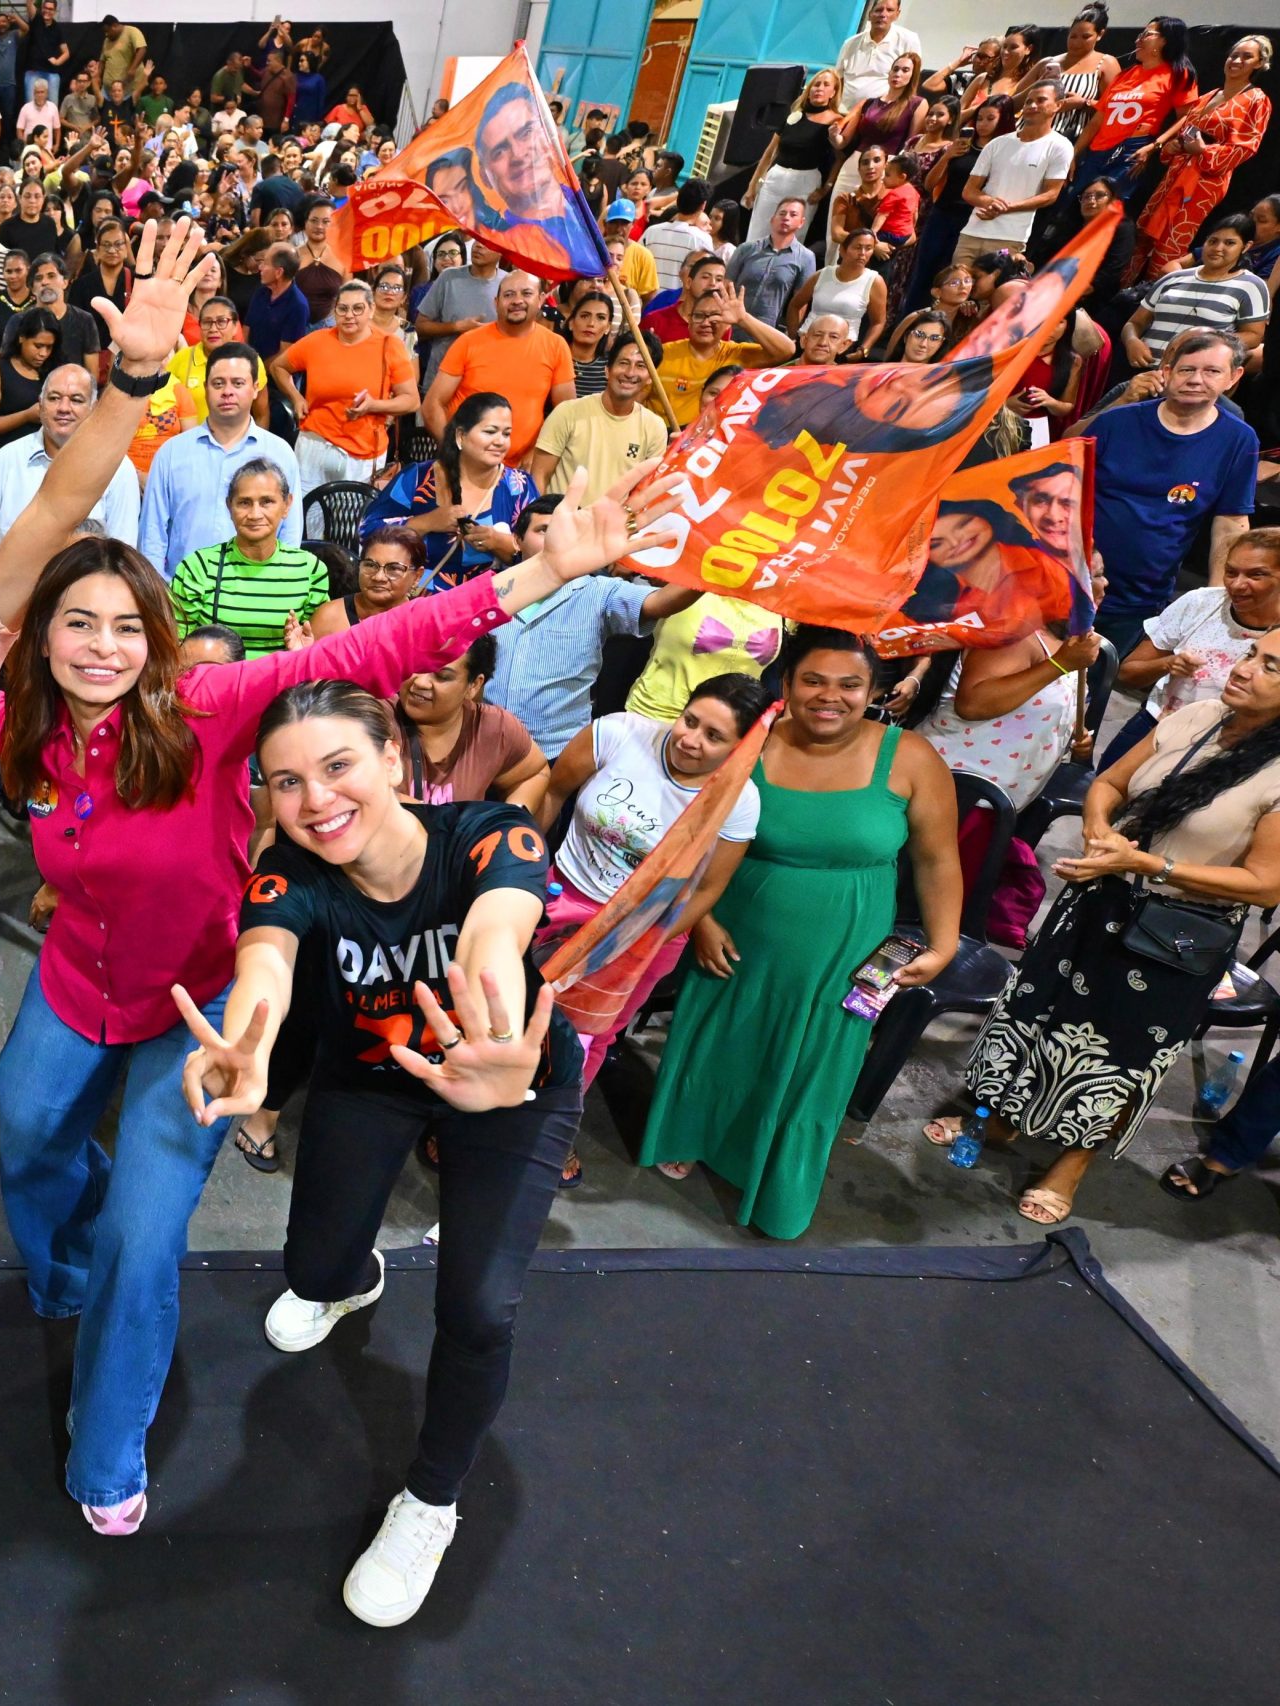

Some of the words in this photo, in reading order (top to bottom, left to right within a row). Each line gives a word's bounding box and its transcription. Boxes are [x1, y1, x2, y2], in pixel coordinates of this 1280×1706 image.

[1106, 101, 1143, 126] 70
[358, 188, 441, 218] 70
[685, 368, 792, 478] DAVID
[627, 480, 732, 567] 70
[701, 428, 848, 588] 70100
[810, 458, 869, 533] VIVI
[826, 475, 878, 552] DEPUTADA
[596, 777, 664, 831] Deus
[470, 826, 545, 875] 70
